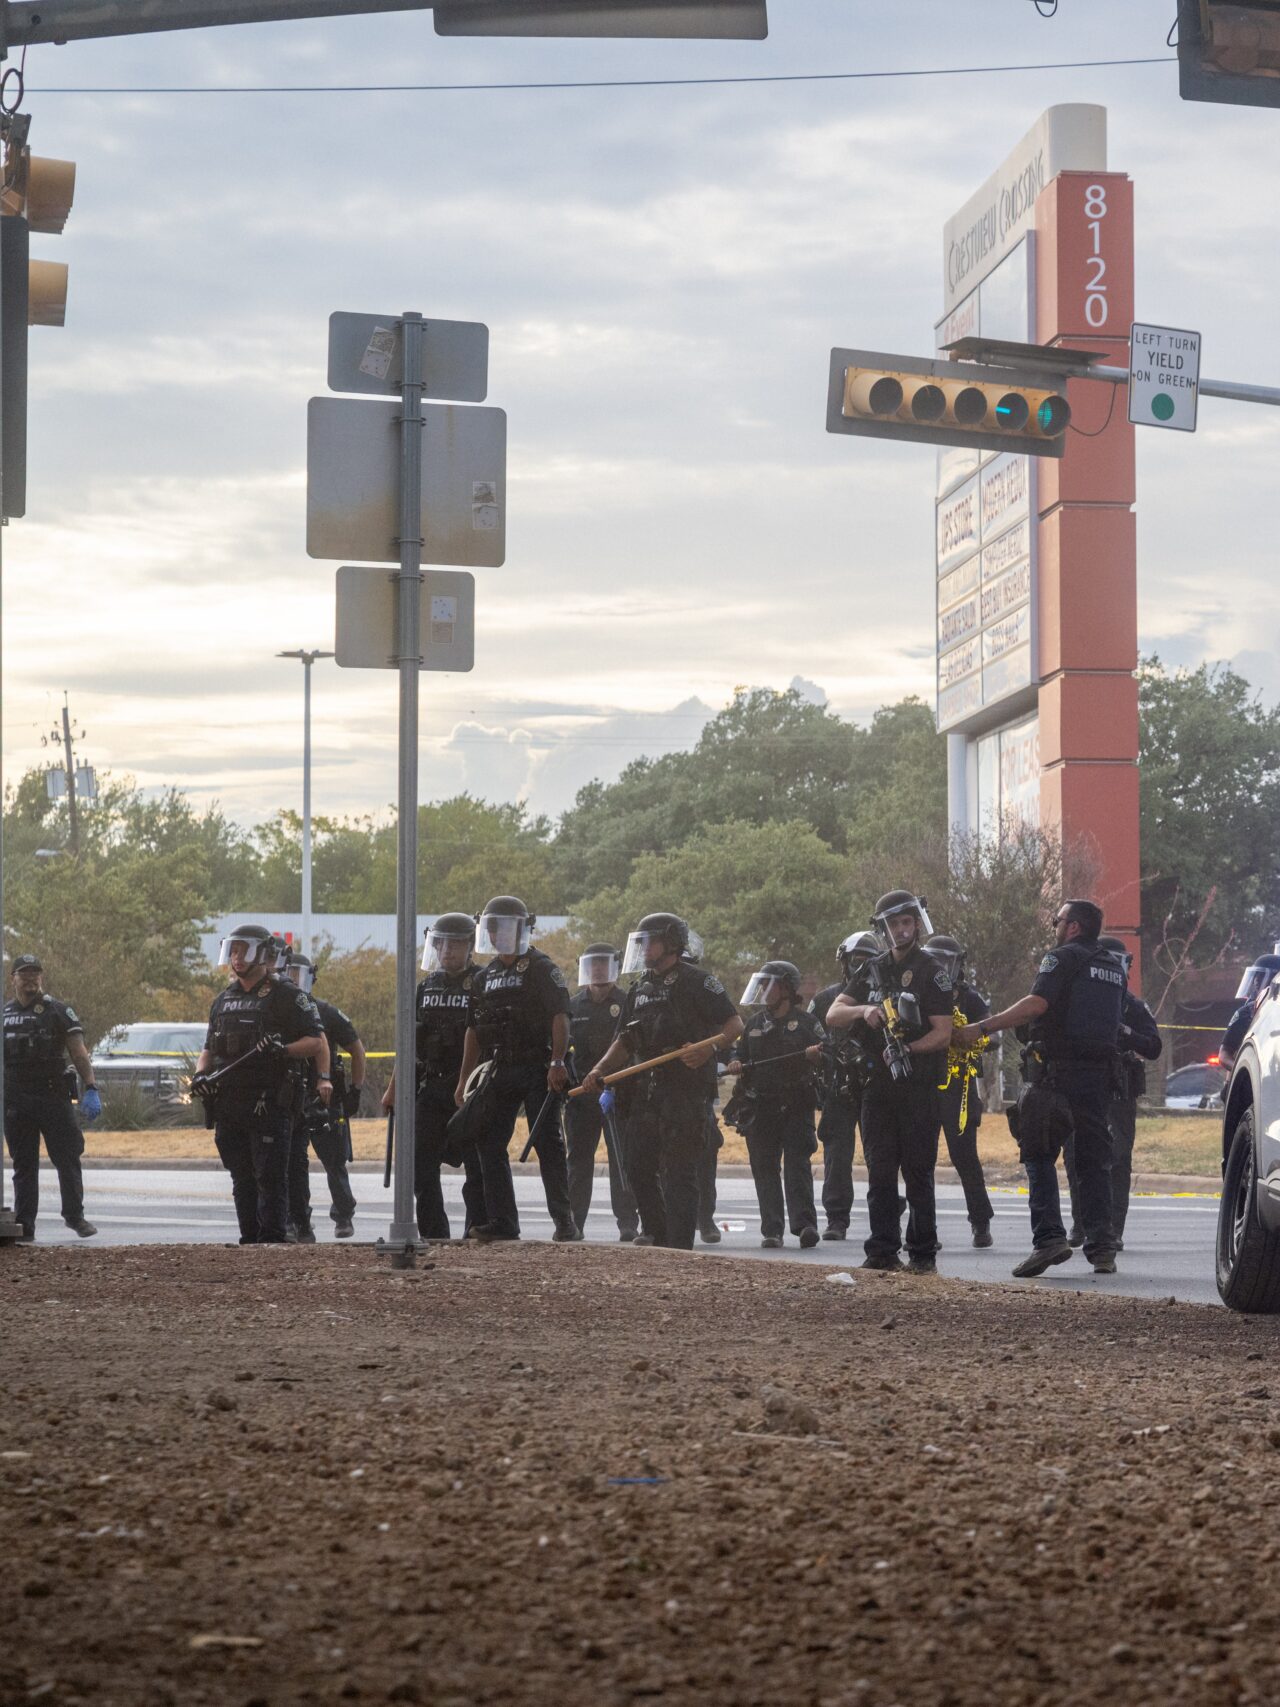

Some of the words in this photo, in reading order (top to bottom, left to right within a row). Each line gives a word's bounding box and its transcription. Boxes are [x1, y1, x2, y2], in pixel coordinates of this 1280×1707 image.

[949, 204, 996, 294] CRESTVIEW
[1000, 148, 1043, 243] CROSSING
[1085, 184, 1108, 327] 8120
[1136, 332, 1161, 347] LEFT
[1169, 336, 1197, 352] TURN
[1147, 351, 1184, 370] YIELD
[1137, 370, 1151, 382] ON
[1159, 373, 1193, 388] GREEN
[485, 975, 523, 992] POLICE
[1090, 967, 1122, 986] POLICE
[422, 995, 469, 1008] POLICE
